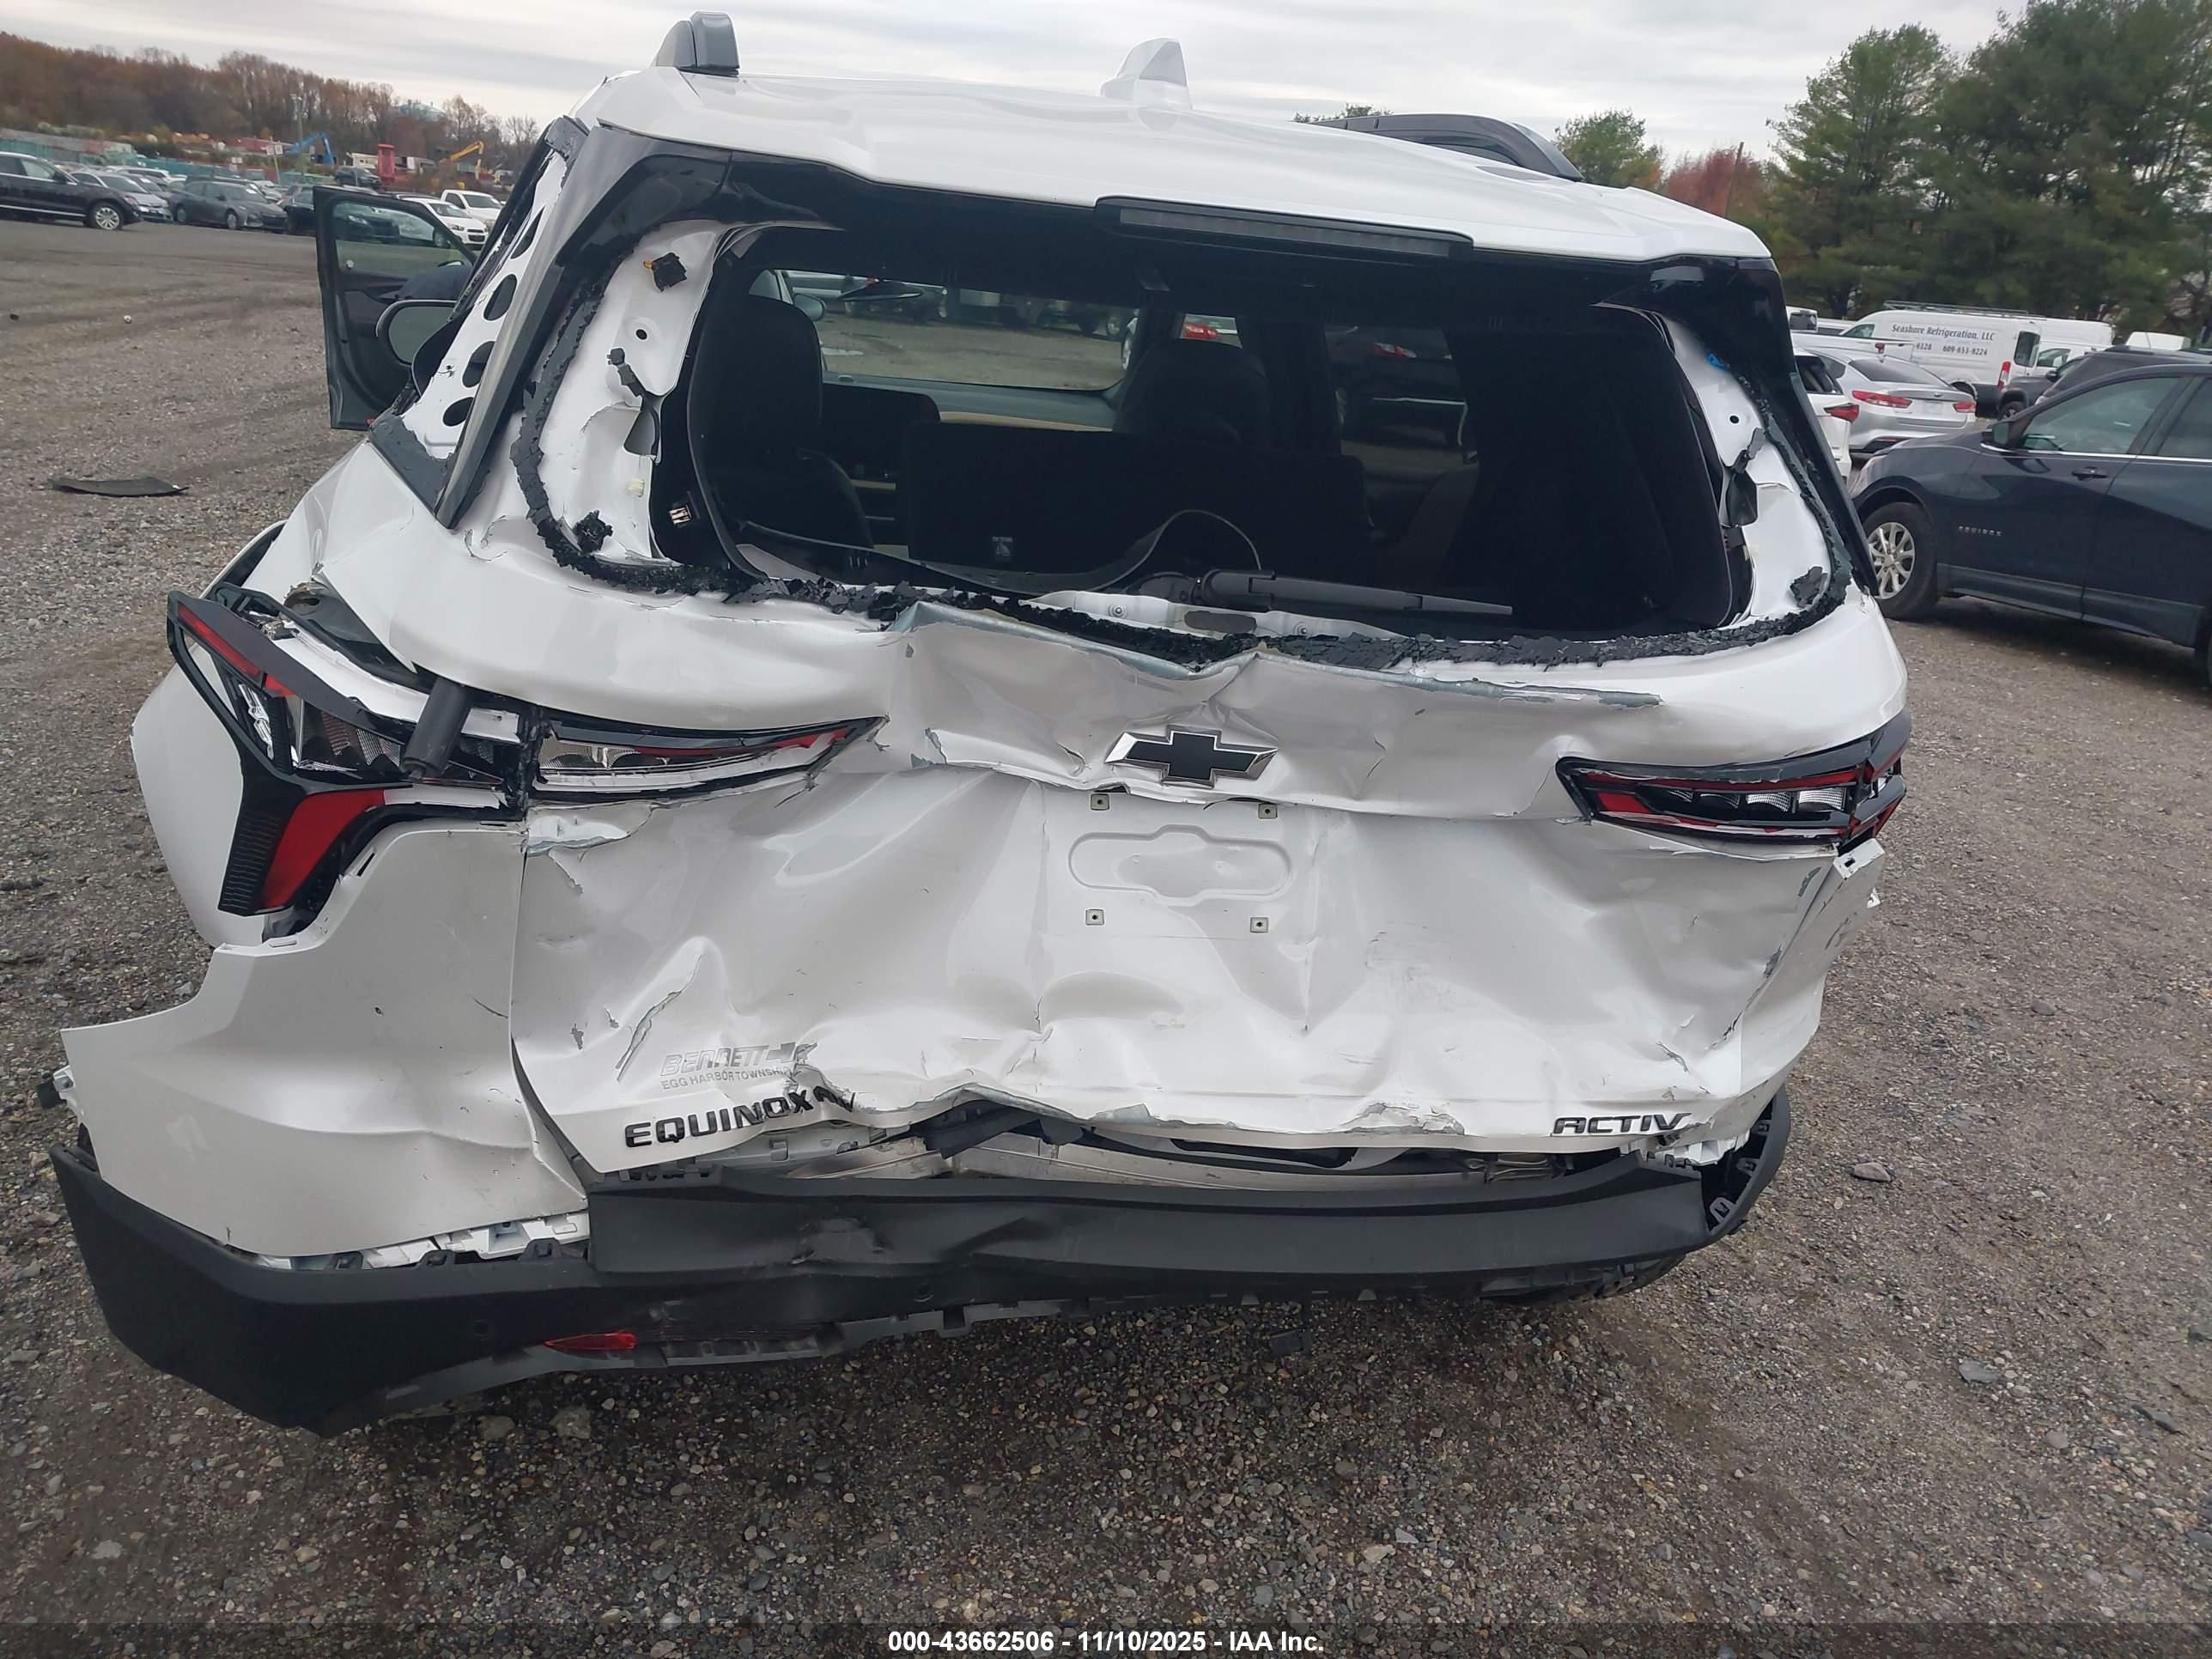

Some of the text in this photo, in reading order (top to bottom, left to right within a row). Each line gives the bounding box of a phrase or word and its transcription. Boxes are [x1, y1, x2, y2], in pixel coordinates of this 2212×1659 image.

[1892, 324, 1925, 335] Seashore
[1981, 331, 1996, 341] LLC
[660, 1045, 769, 1076] BENNETT
[660, 1079, 689, 1090] EGG
[690, 1071, 733, 1087] HARBOR
[624, 1089, 814, 1148] EQUINOX
[1553, 1113, 1692, 1134] ACTIV
